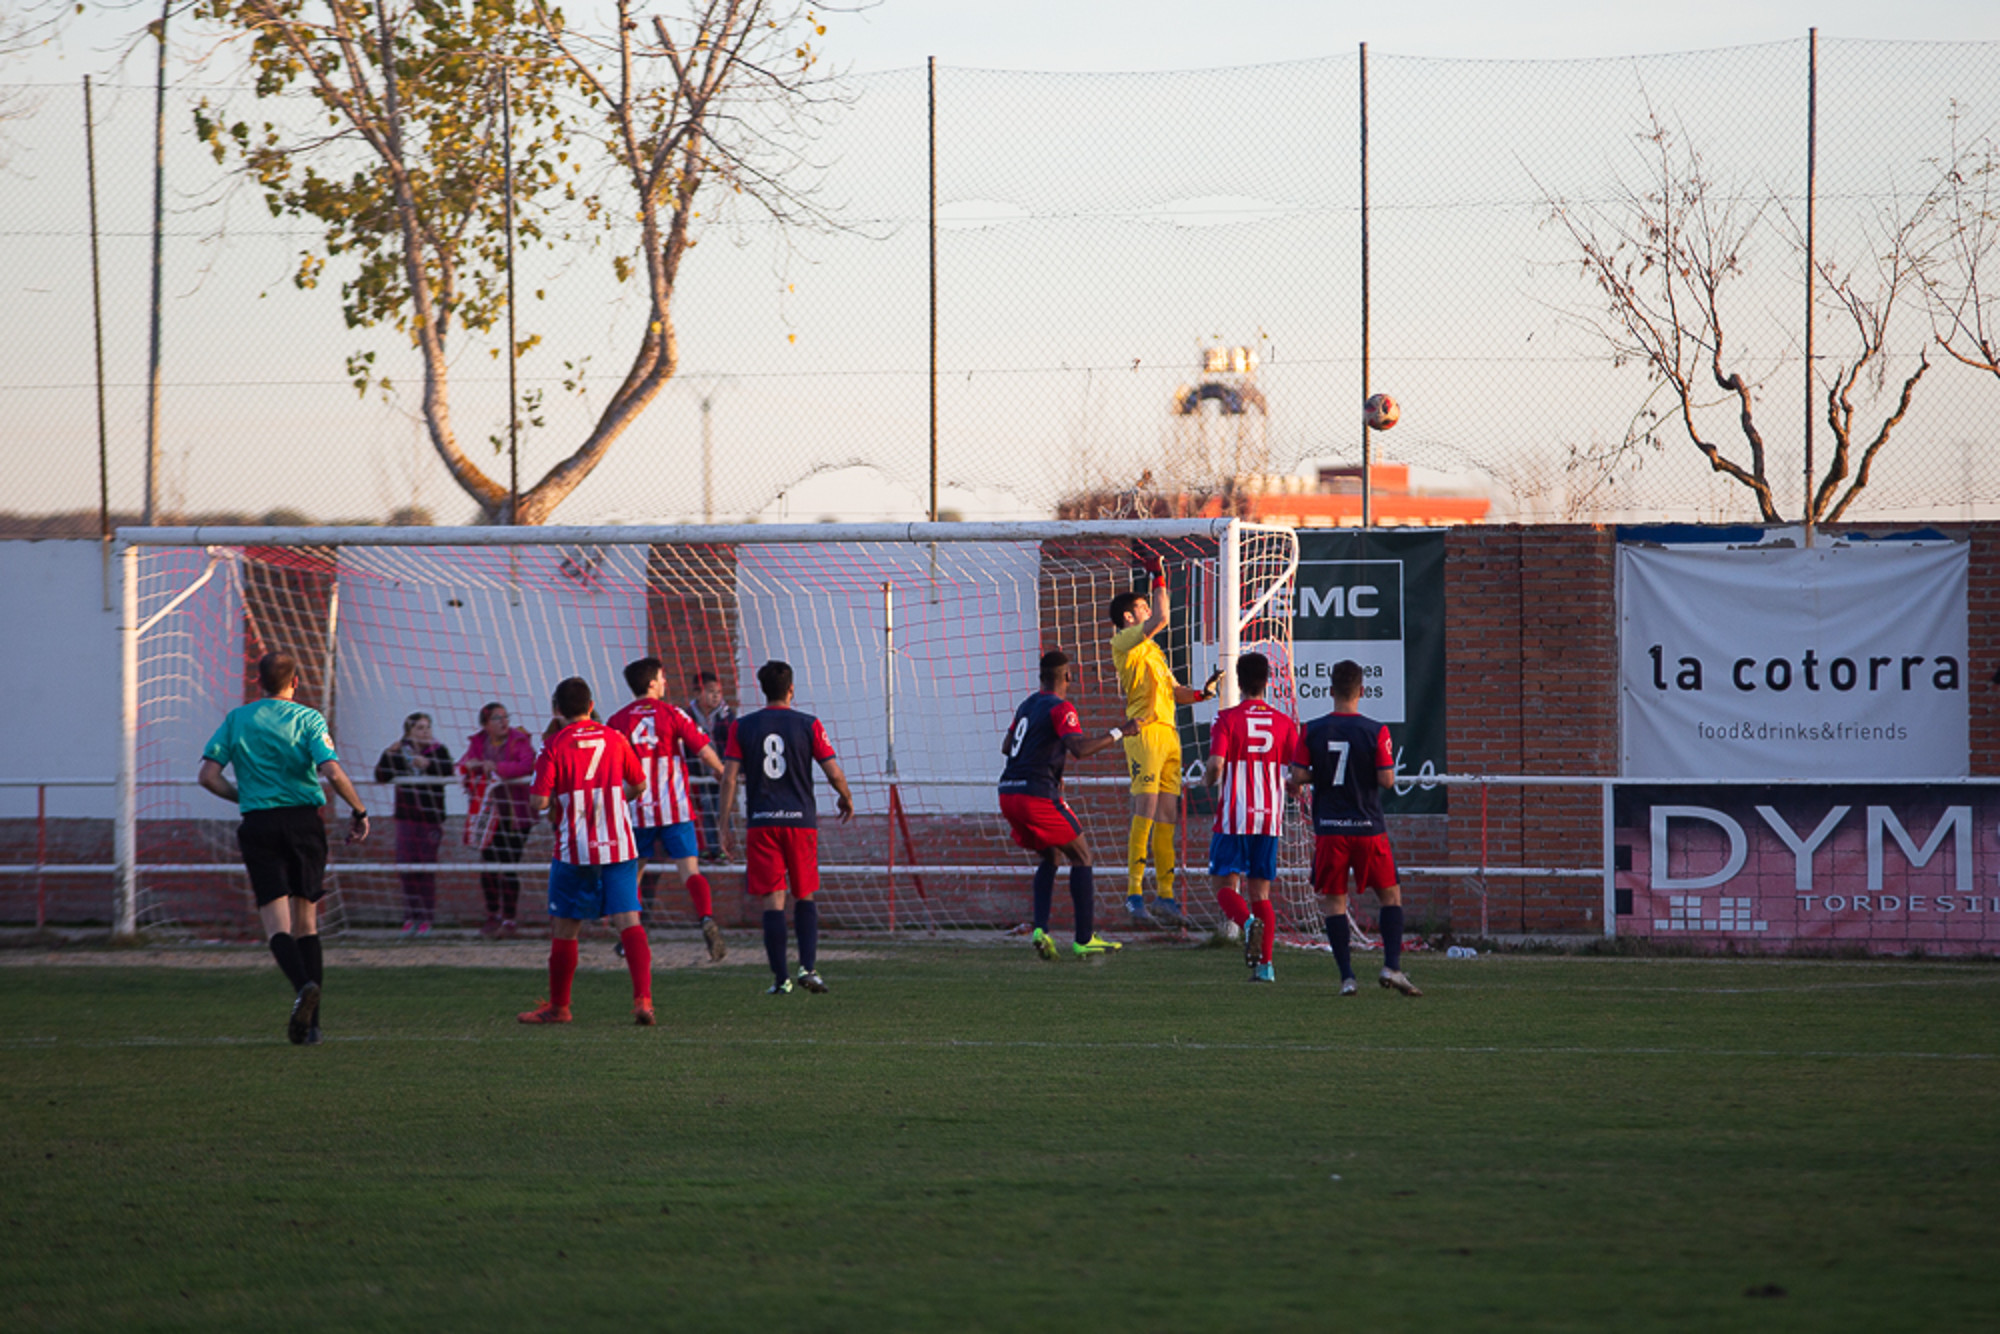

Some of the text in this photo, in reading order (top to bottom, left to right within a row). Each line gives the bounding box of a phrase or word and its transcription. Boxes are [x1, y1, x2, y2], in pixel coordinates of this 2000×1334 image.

[1240, 586, 1379, 617] EMC
[1648, 644, 1960, 692] la cotorra
[1299, 683, 1383, 698] Ceres
[631, 716, 659, 750] 4
[1010, 717, 1029, 758] 9
[1246, 717, 1274, 754] 5
[1698, 721, 1908, 741] food&drinks&friends
[577, 738, 606, 781] 7
[763, 733, 787, 780] 8
[1327, 740, 1351, 787] 7
[1650, 805, 2000, 891] DYM
